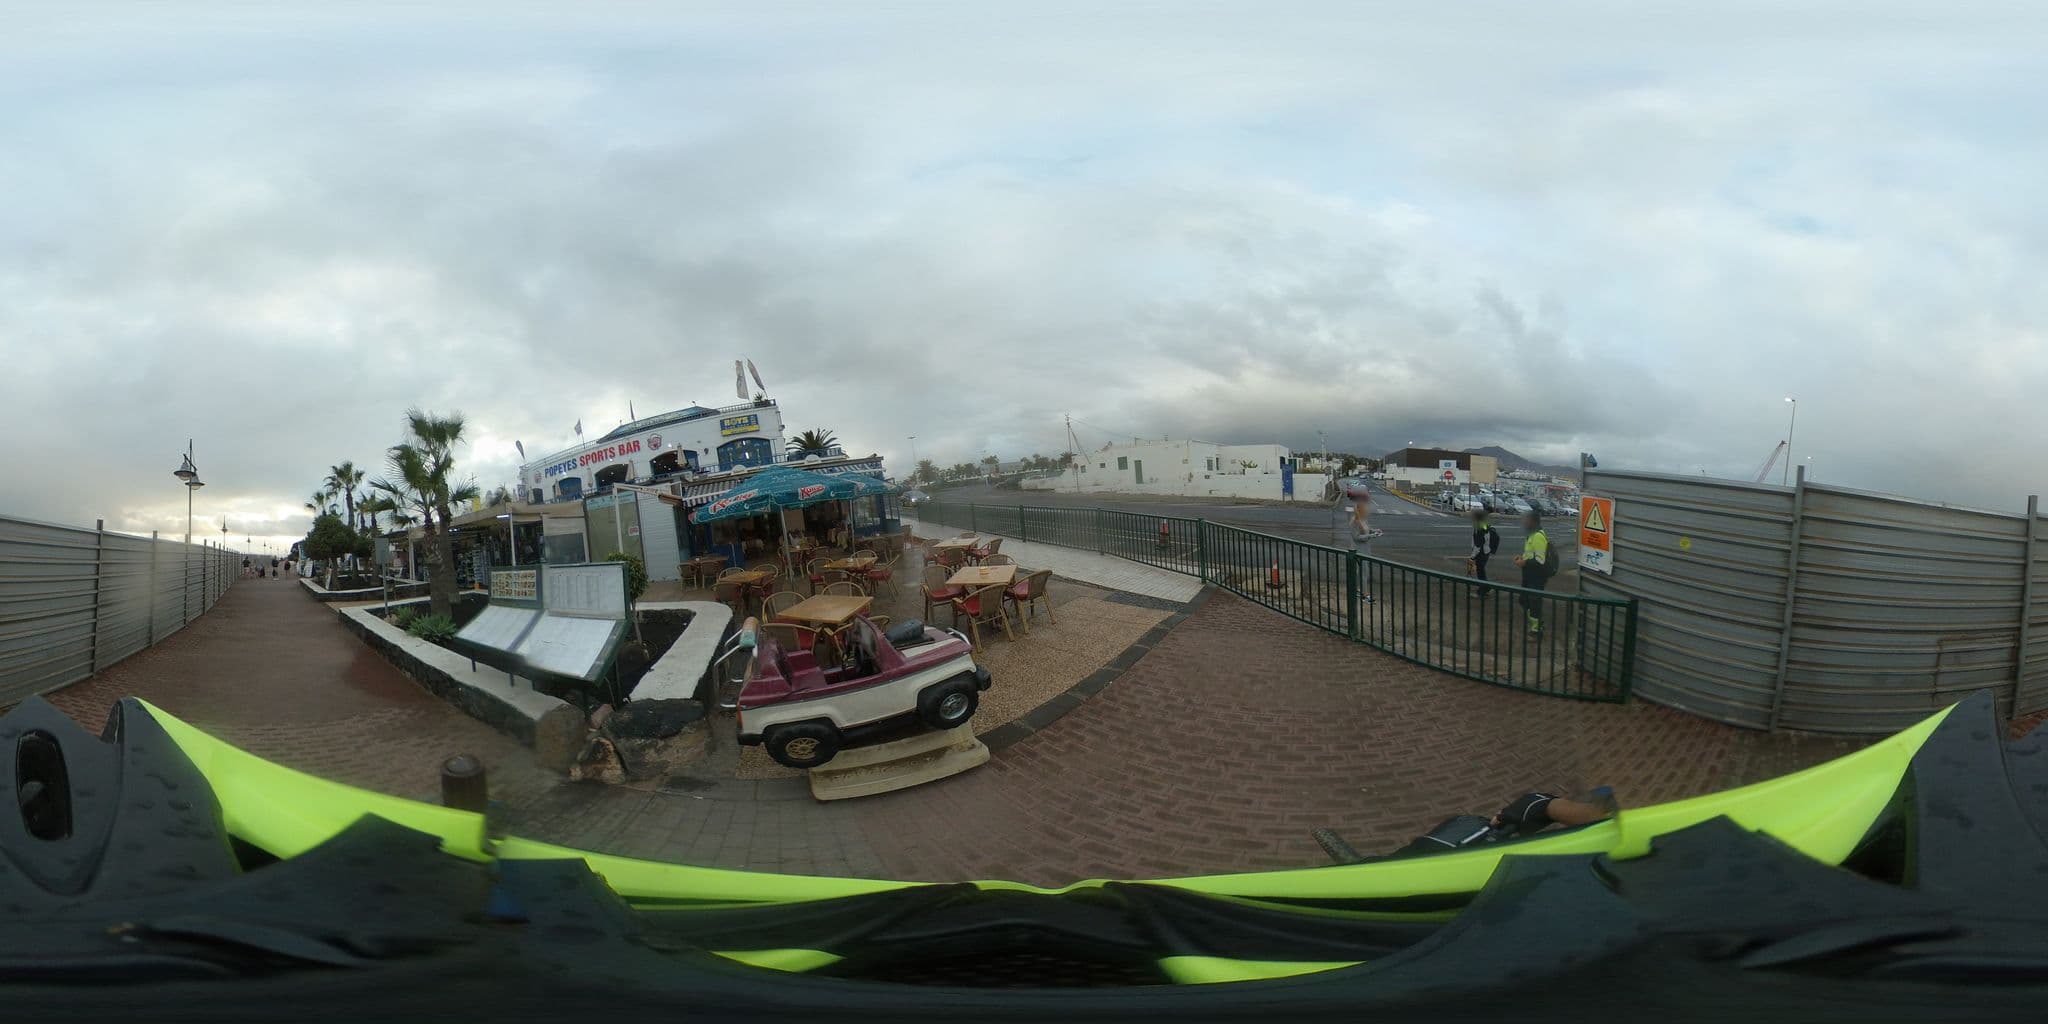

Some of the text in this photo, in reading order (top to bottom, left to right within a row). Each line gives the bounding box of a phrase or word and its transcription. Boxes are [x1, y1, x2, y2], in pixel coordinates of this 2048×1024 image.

[544, 440, 641, 478] POPEYES SPORTS BAR
